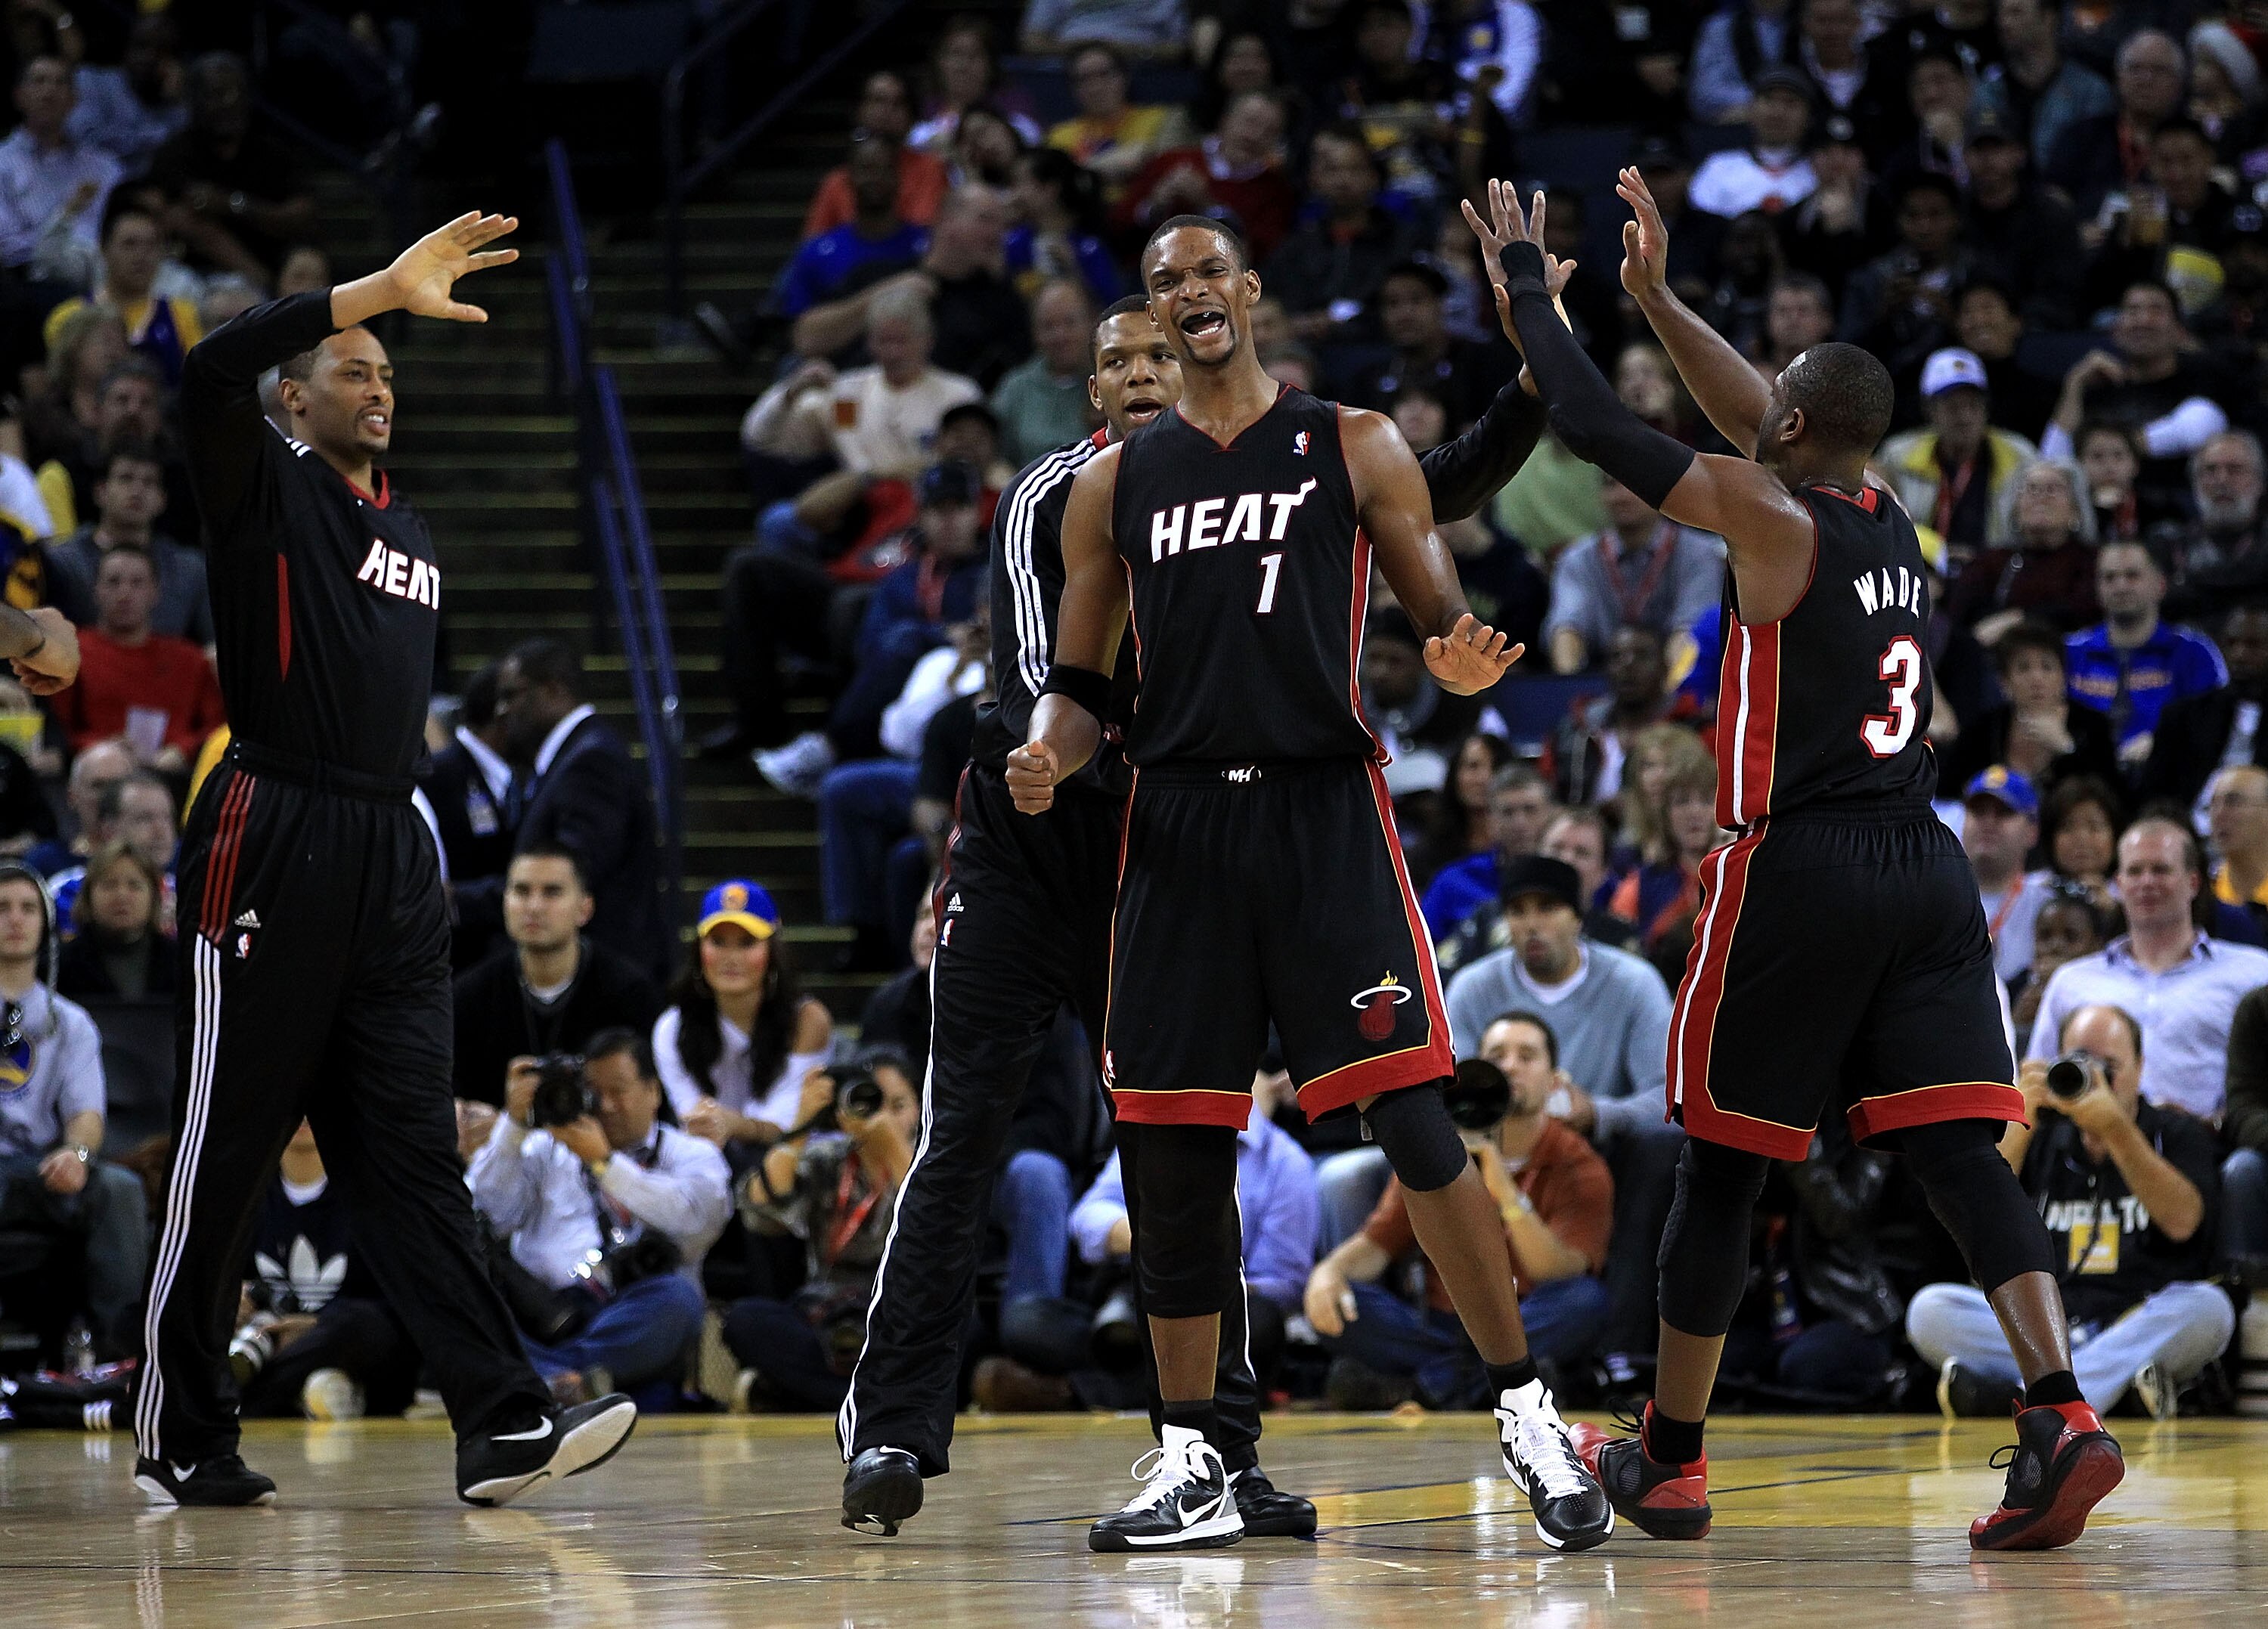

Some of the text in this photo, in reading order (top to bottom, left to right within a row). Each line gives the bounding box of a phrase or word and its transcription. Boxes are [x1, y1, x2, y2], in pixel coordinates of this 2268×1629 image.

[1151, 476, 1317, 563] HEAT
[1256, 553, 1282, 614] 1
[1853, 566, 1922, 619] WADE
[1860, 634, 1923, 759] 3
